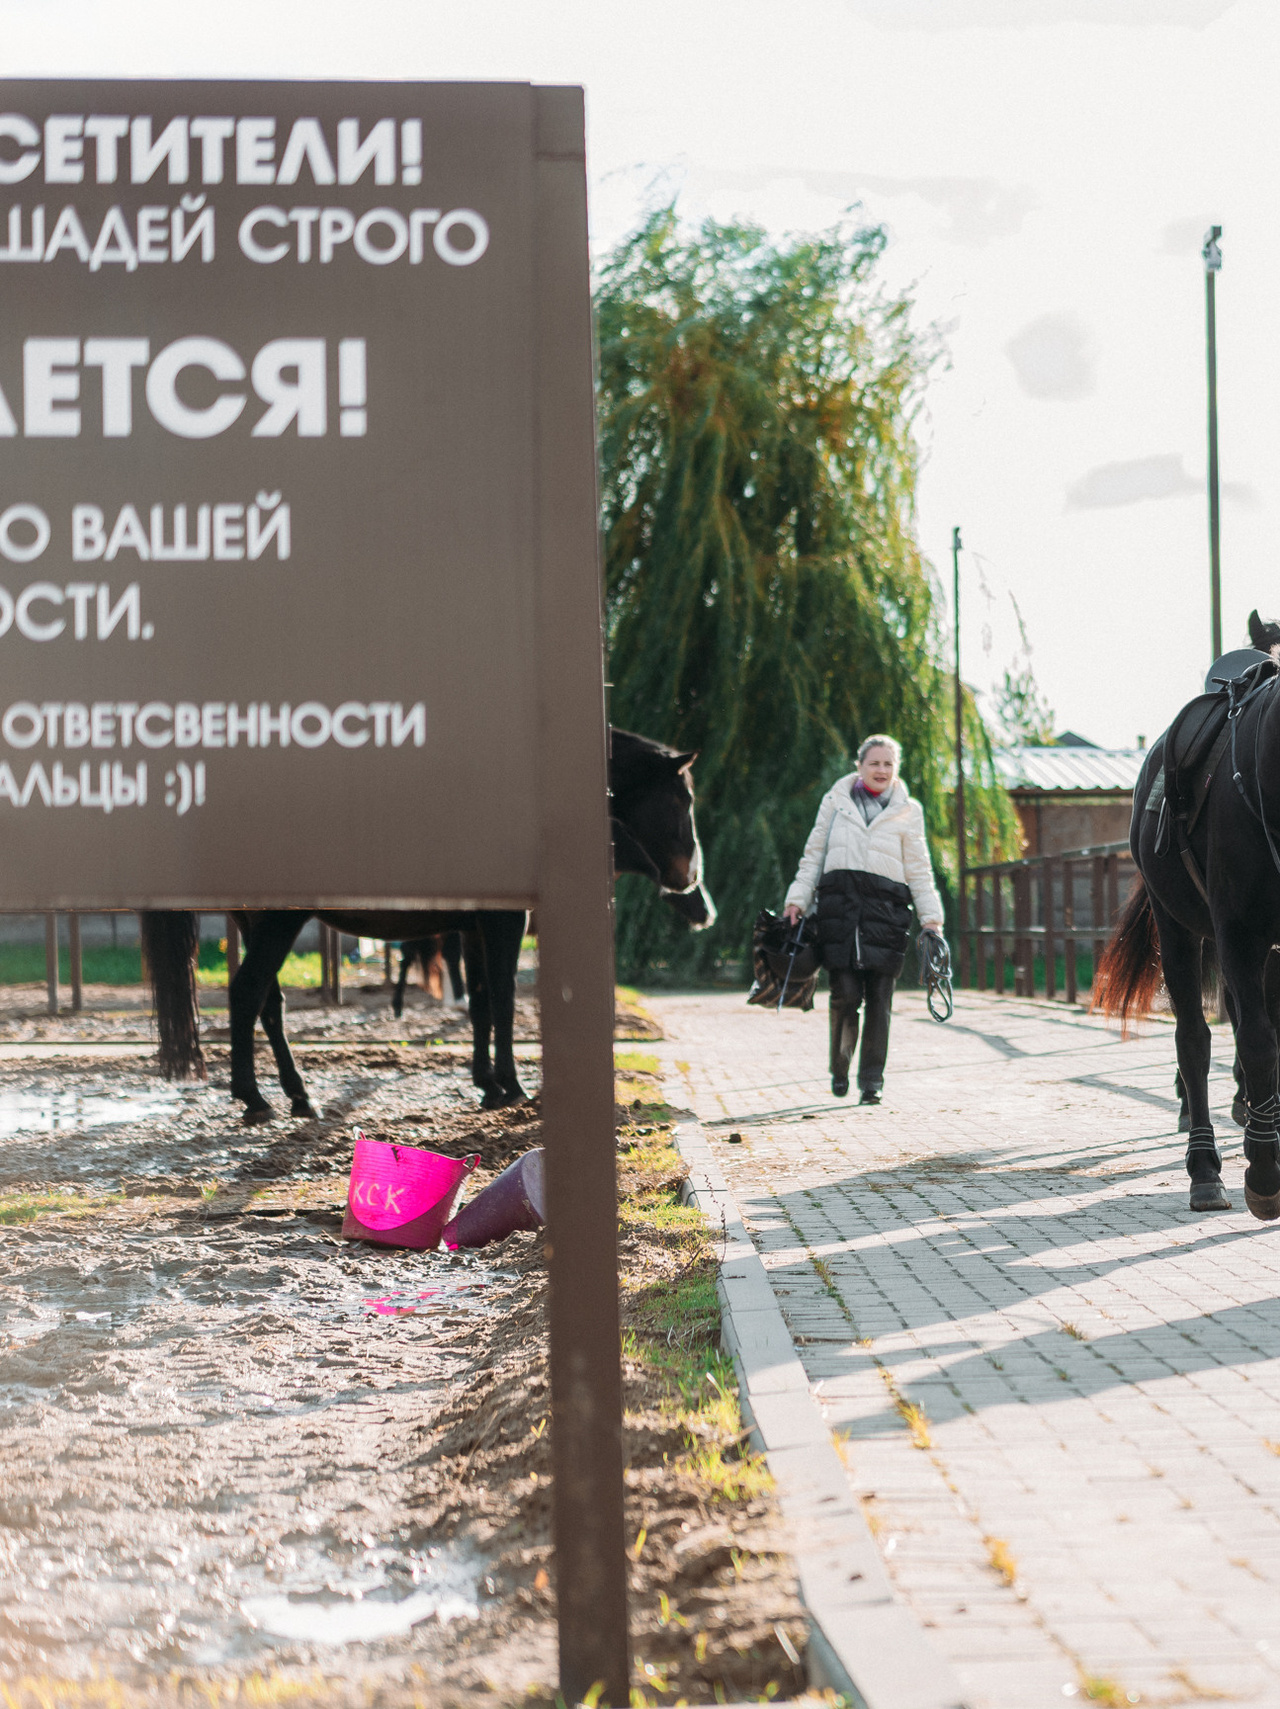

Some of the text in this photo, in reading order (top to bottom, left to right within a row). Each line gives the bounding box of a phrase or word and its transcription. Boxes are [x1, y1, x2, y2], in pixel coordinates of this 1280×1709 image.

[238, 206, 490, 266] СТРОГО
[0, 336, 368, 439] ЕТСЯ!
[71, 491, 291, 562] ВАШЕЙ
[0, 582, 155, 642] СТИ.
[1, 701, 426, 749] ОТВЕТСВЕННОСТИ
